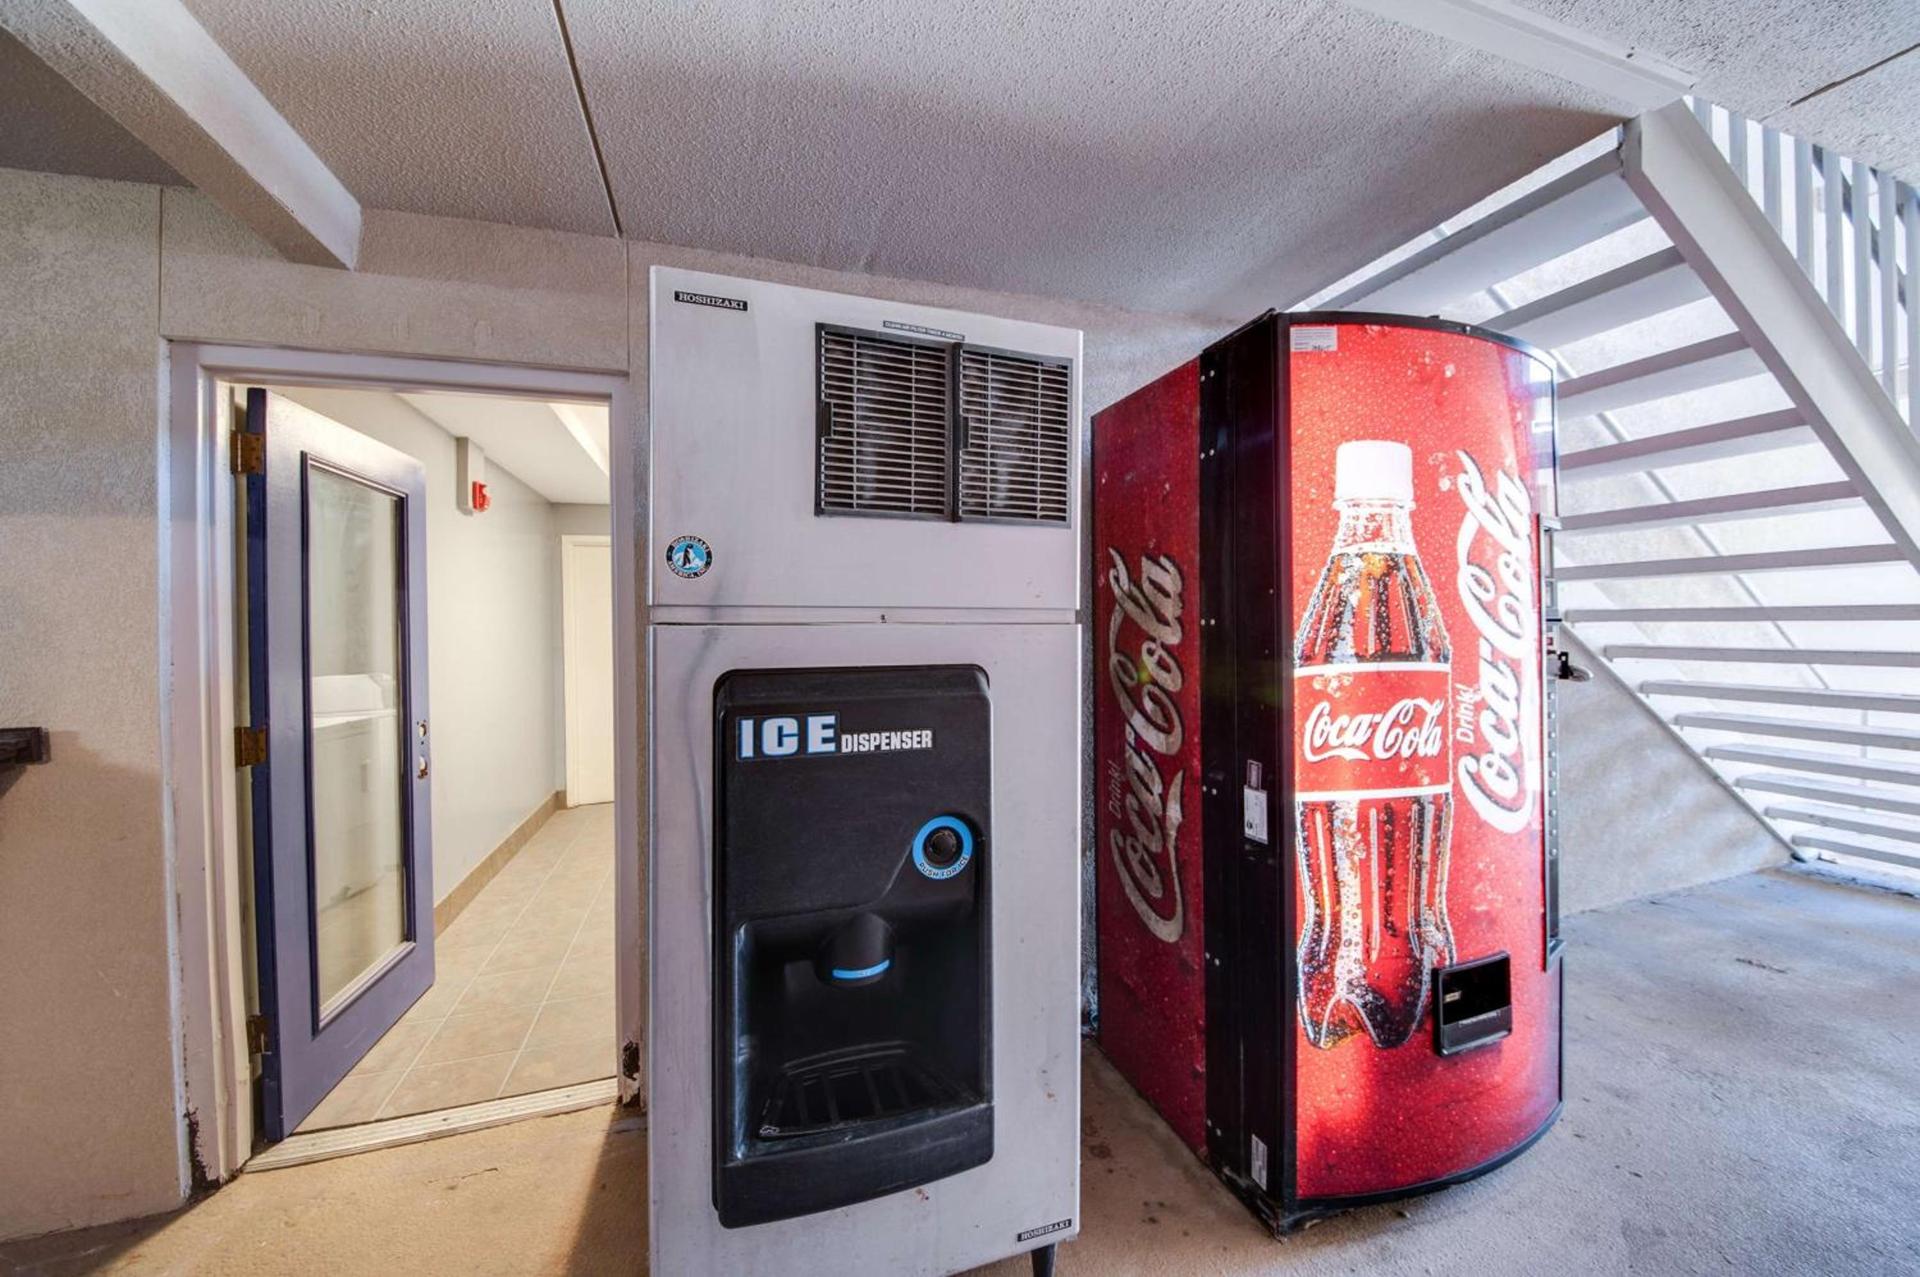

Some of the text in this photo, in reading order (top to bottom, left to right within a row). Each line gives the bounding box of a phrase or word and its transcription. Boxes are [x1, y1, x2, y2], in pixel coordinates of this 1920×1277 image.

[678, 292, 744, 309] HOSHIZAKI
[1457, 449, 1533, 834] Coca-Cola
[740, 715, 933, 758] ICE DISPENSER
[1108, 547, 1184, 942] Coca-Cola
[1303, 697, 1445, 763] Coca-Cola
[1020, 1220, 1070, 1241] HOSHIZAKI
